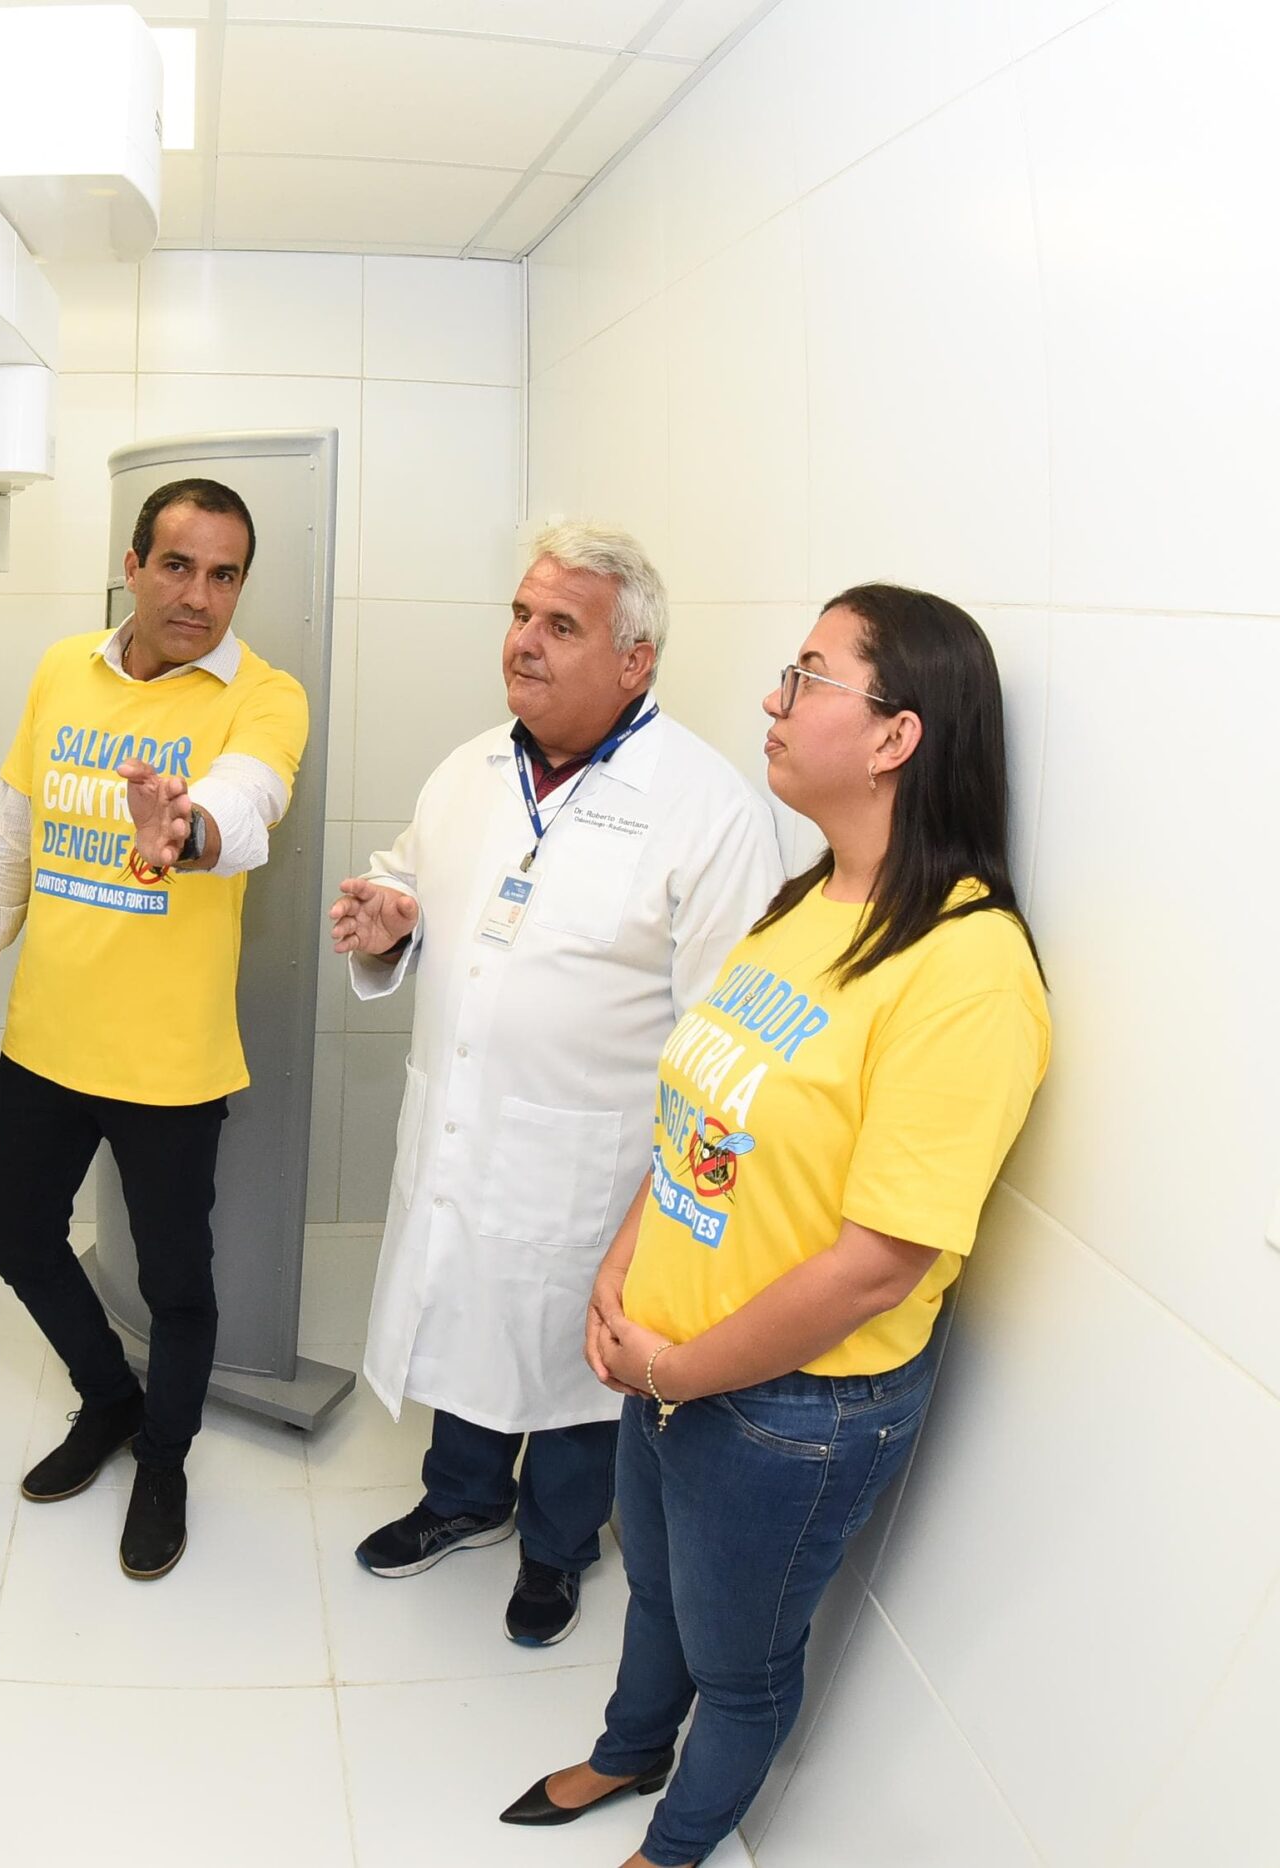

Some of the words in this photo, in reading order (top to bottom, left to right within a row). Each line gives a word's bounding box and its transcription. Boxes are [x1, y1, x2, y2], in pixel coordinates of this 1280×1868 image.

[50, 725, 192, 777] SALVADOR
[43, 770, 134, 824] CONTR
[586, 810, 615, 821] Roberto
[618, 817, 648, 829] Santana
[42, 820, 130, 868] DENGUE
[35, 873, 68, 893] JUNTOS
[68, 881, 98, 900] SOMOS
[97, 887, 125, 906] MAIS
[125, 892, 165, 910] FORTES
[705, 964, 829, 1062] ALVADOR
[662, 1011, 746, 1104] ONTRA
[720, 1062, 769, 1130] A
[677, 1194, 720, 1240] FOTES
